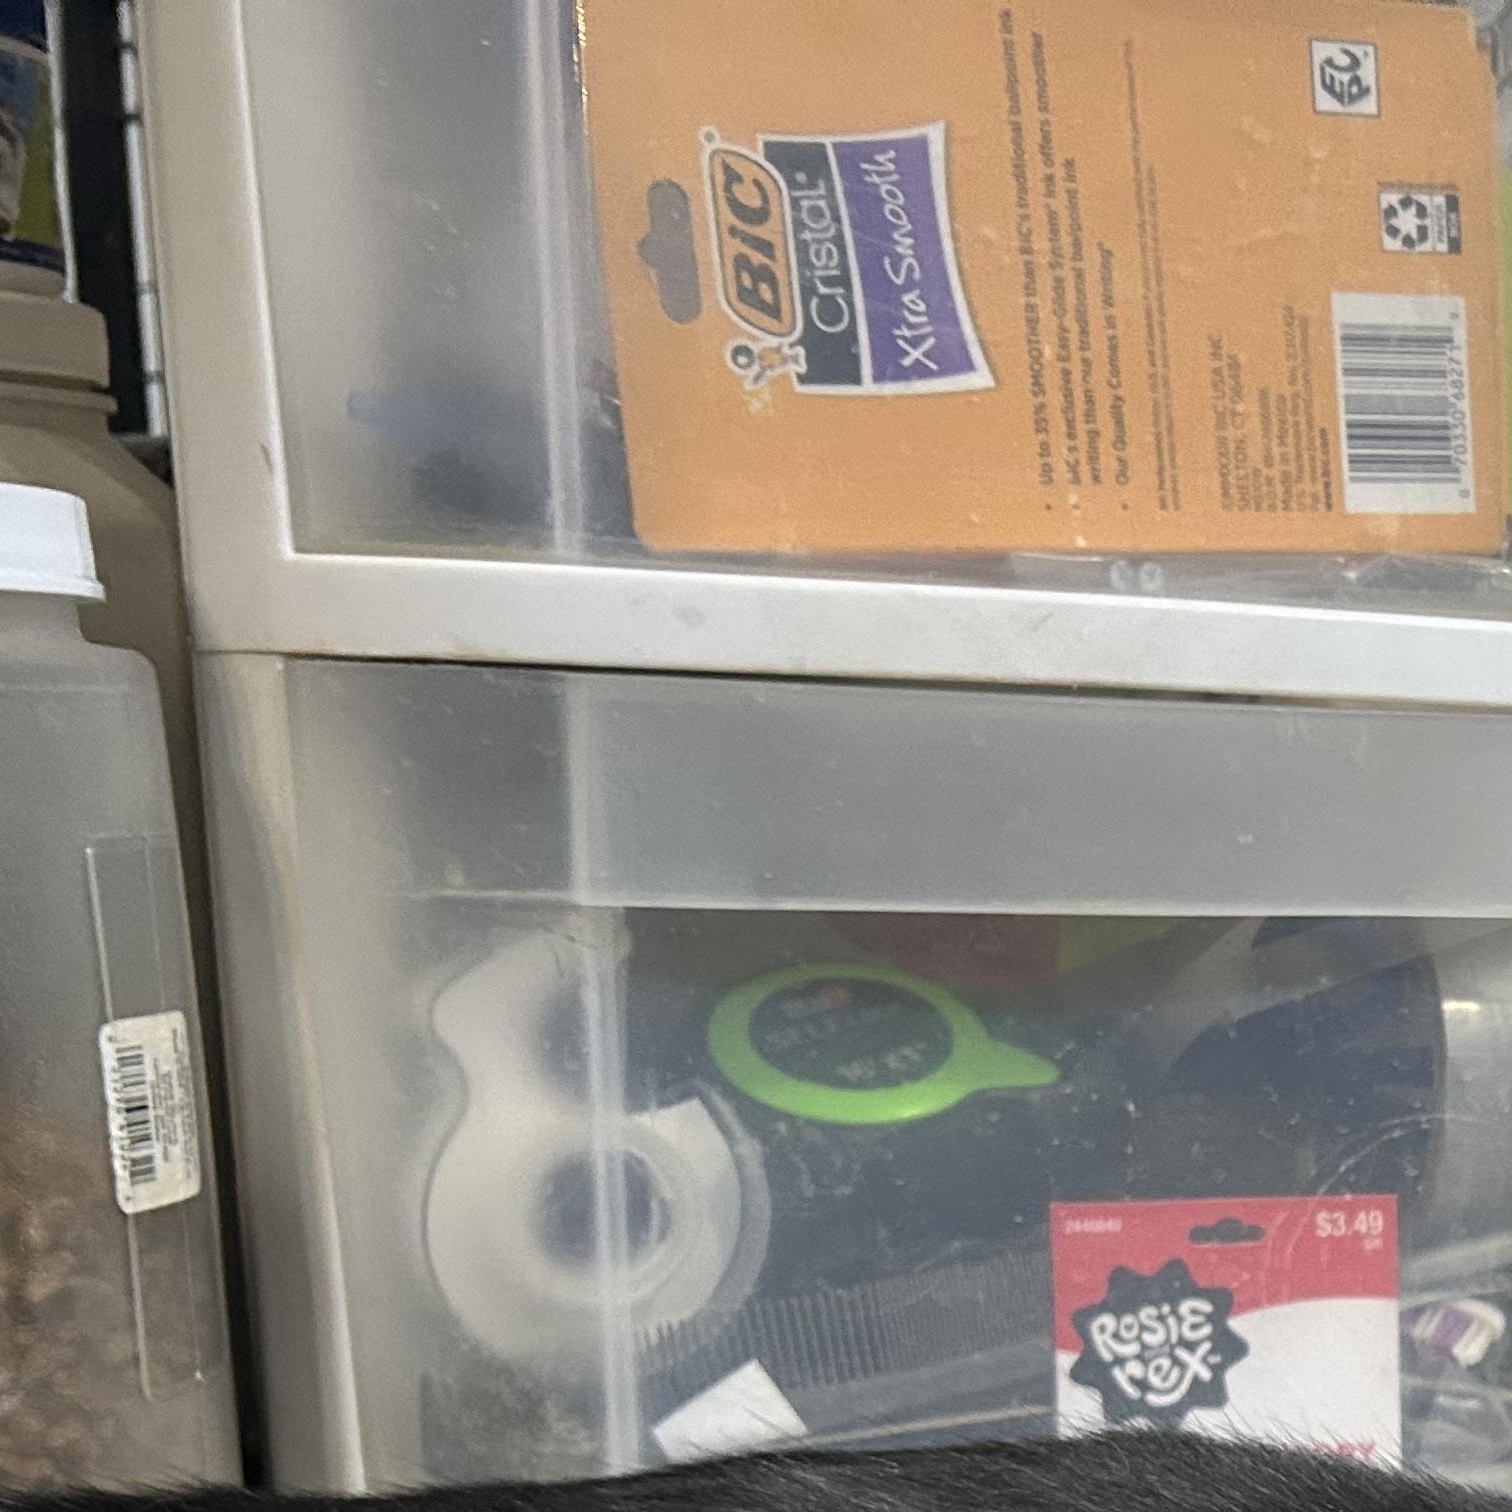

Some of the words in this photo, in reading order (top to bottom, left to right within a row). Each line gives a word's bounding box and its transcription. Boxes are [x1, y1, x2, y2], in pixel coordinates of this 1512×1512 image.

[721, 159, 783, 322] BIC
[859, 147, 922, 288] Smooth
[1023, 259, 1036, 297] than
[892, 289, 938, 371] Xtra
[1103, 314, 1116, 329] in
[1025, 303, 1045, 396] SMOOTHER
[1104, 334, 1120, 389] Comes
[1037, 440, 1050, 458] to
[1109, 394, 1128, 452] Quality
[1452, 410, 1468, 466] 70330
[1039, 462, 1053, 485] Up
[1114, 455, 1128, 484] Our
[1315, 1209, 1384, 1238] $3.49
